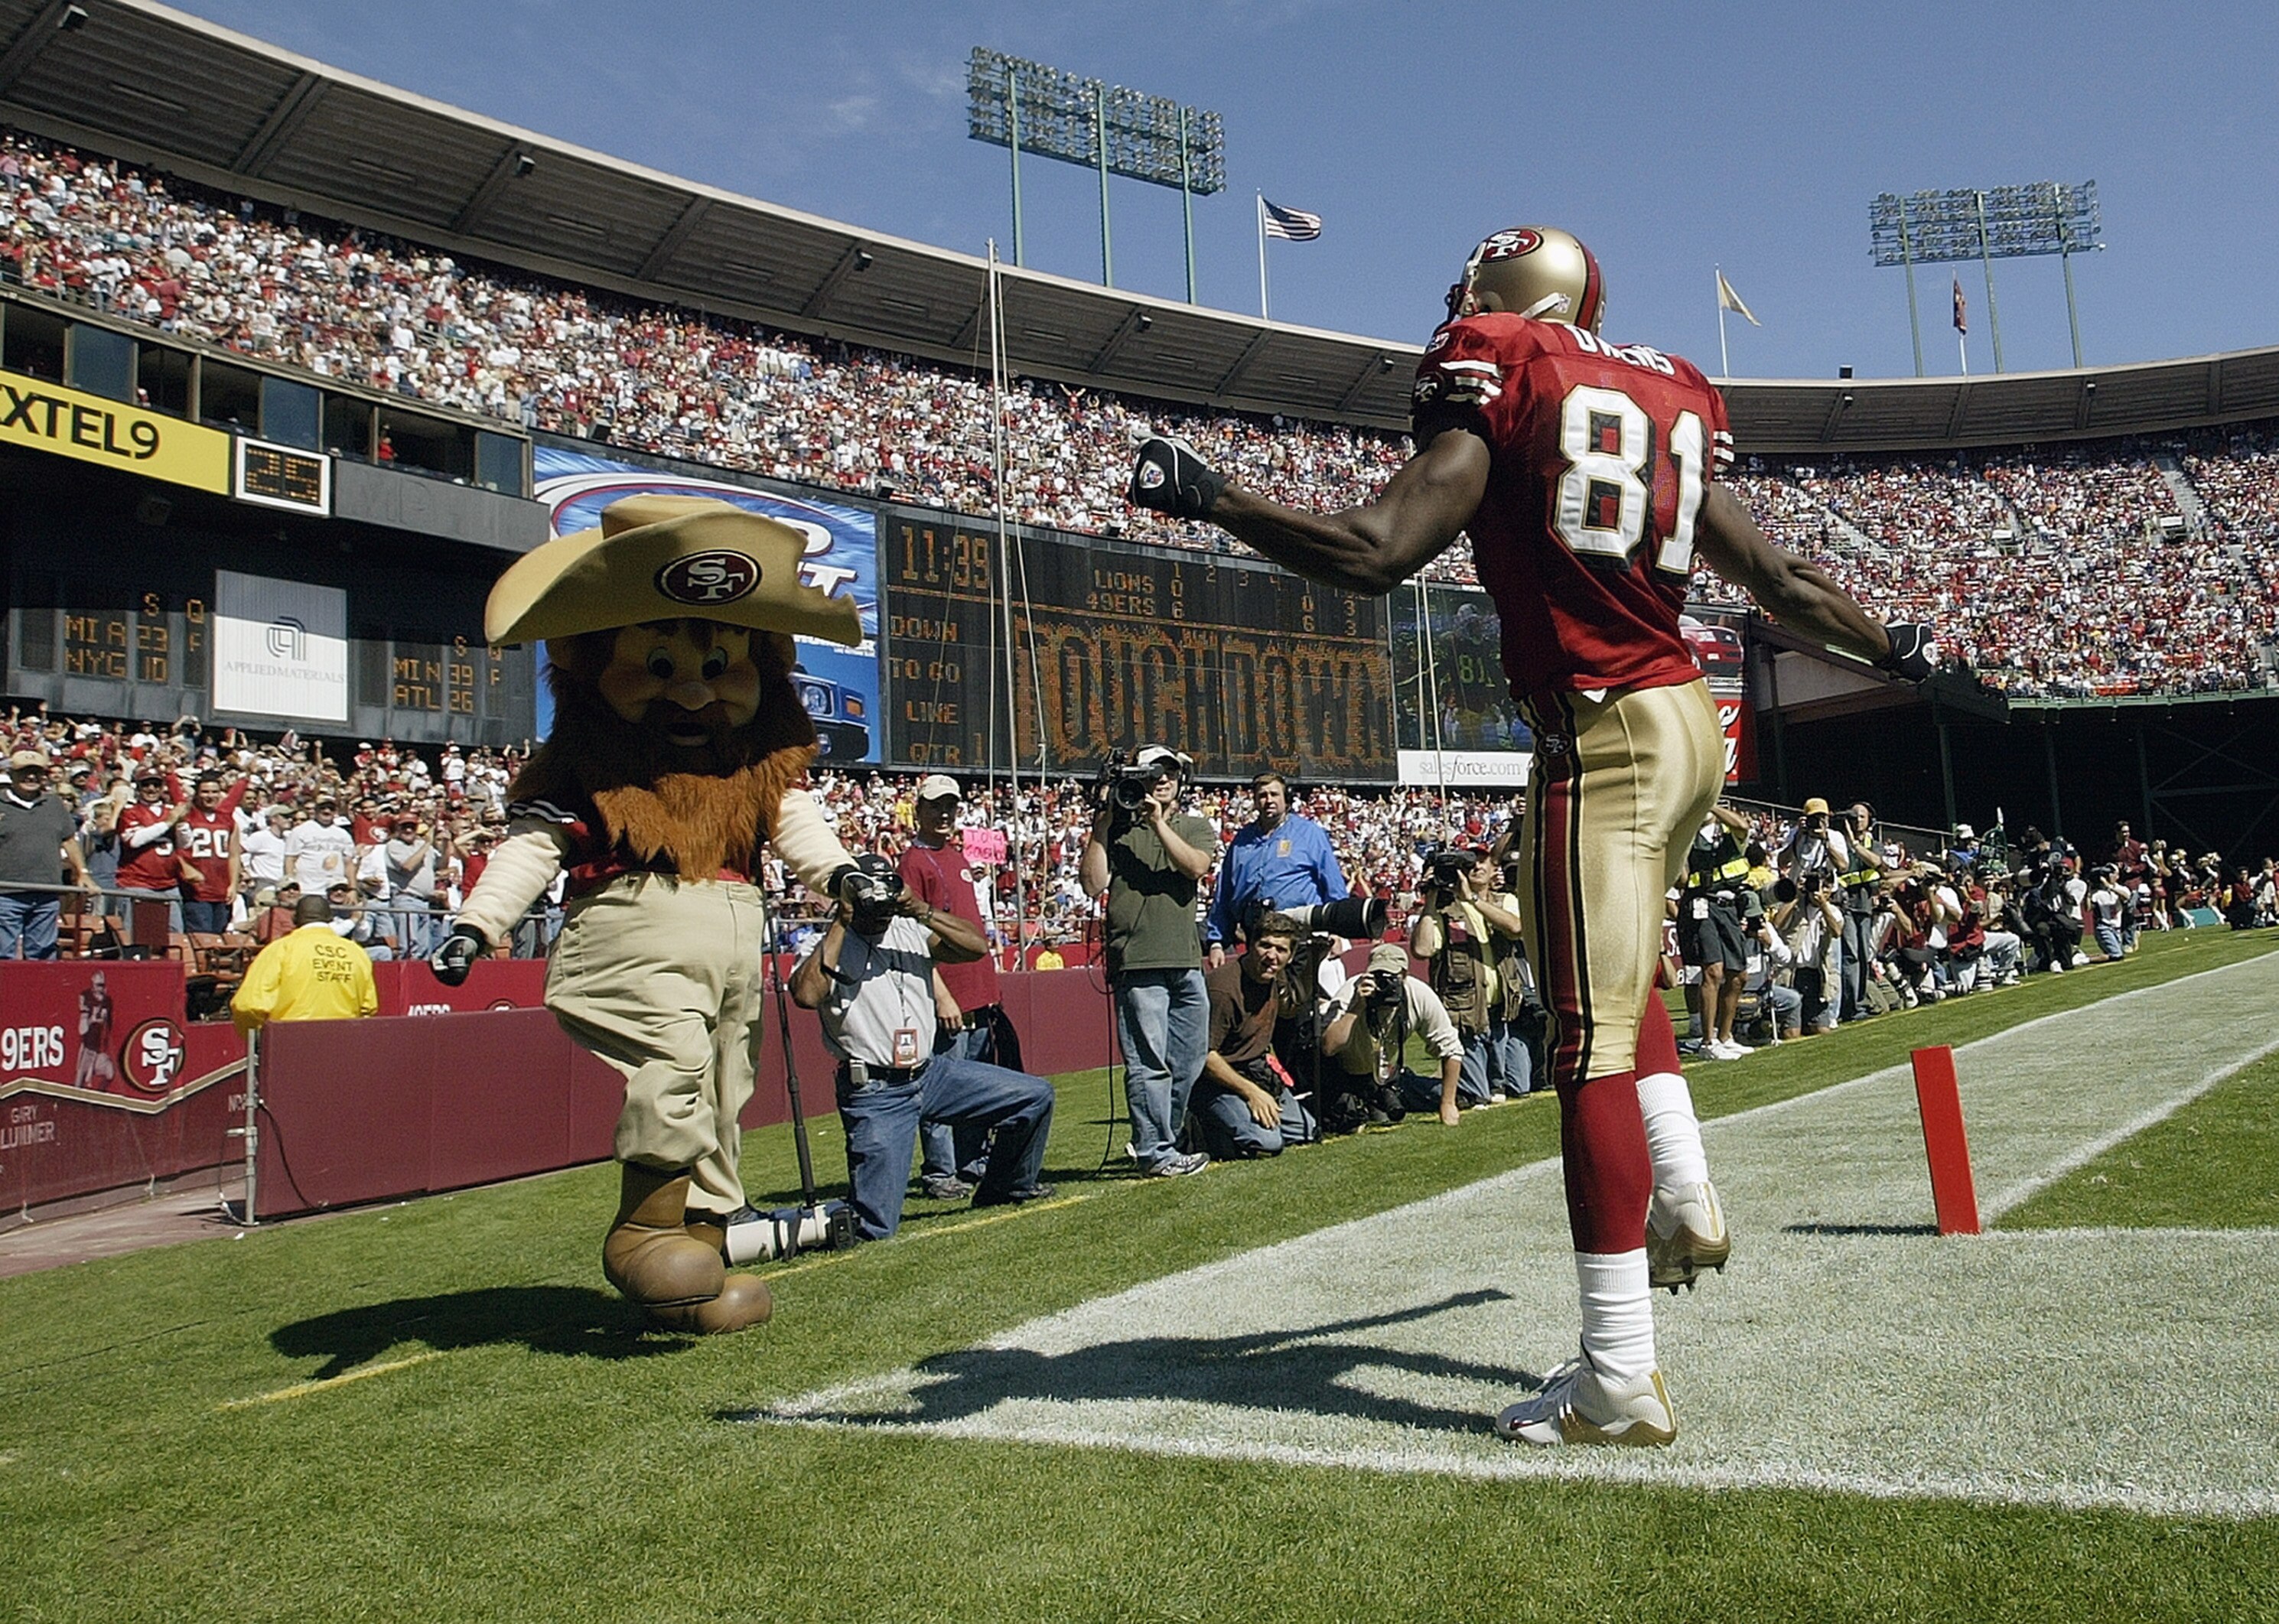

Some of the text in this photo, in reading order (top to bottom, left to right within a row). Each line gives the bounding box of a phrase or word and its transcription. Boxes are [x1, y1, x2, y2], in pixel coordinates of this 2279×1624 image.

[1555, 384, 1708, 575] 81
[900, 526, 989, 589] 11:39
[688, 558, 744, 600] SF
[1094, 569, 1155, 594] LIONS
[1170, 579, 1183, 597] 0
[1206, 564, 1216, 583] 2
[1238, 569, 1249, 587] 3
[144, 593, 160, 617] S
[1086, 591, 1156, 616] 49ERS
[1171, 601, 1183, 620] 6
[1302, 614, 1315, 633] 6
[64, 615, 127, 648] MIA
[136, 624, 168, 653] 23
[890, 615, 959, 642] DOWN
[64, 649, 167, 683] NYG 10
[224, 660, 345, 685] APPLIED MATERIALS
[392, 656, 501, 686] MIN 39 F
[888, 658, 961, 683] TO GO
[394, 684, 474, 713] ATL 26
[907, 700, 959, 724] LINE
[1419, 754, 1522, 783] salesforce.com
[192, 827, 230, 859] 20
[312, 958, 352, 971] EVENT
[314, 944, 347, 958] CSC
[317, 971, 351, 983] STAFF
[1, 1025, 65, 1072] 9ERS
[141, 1027, 181, 1085] SF
